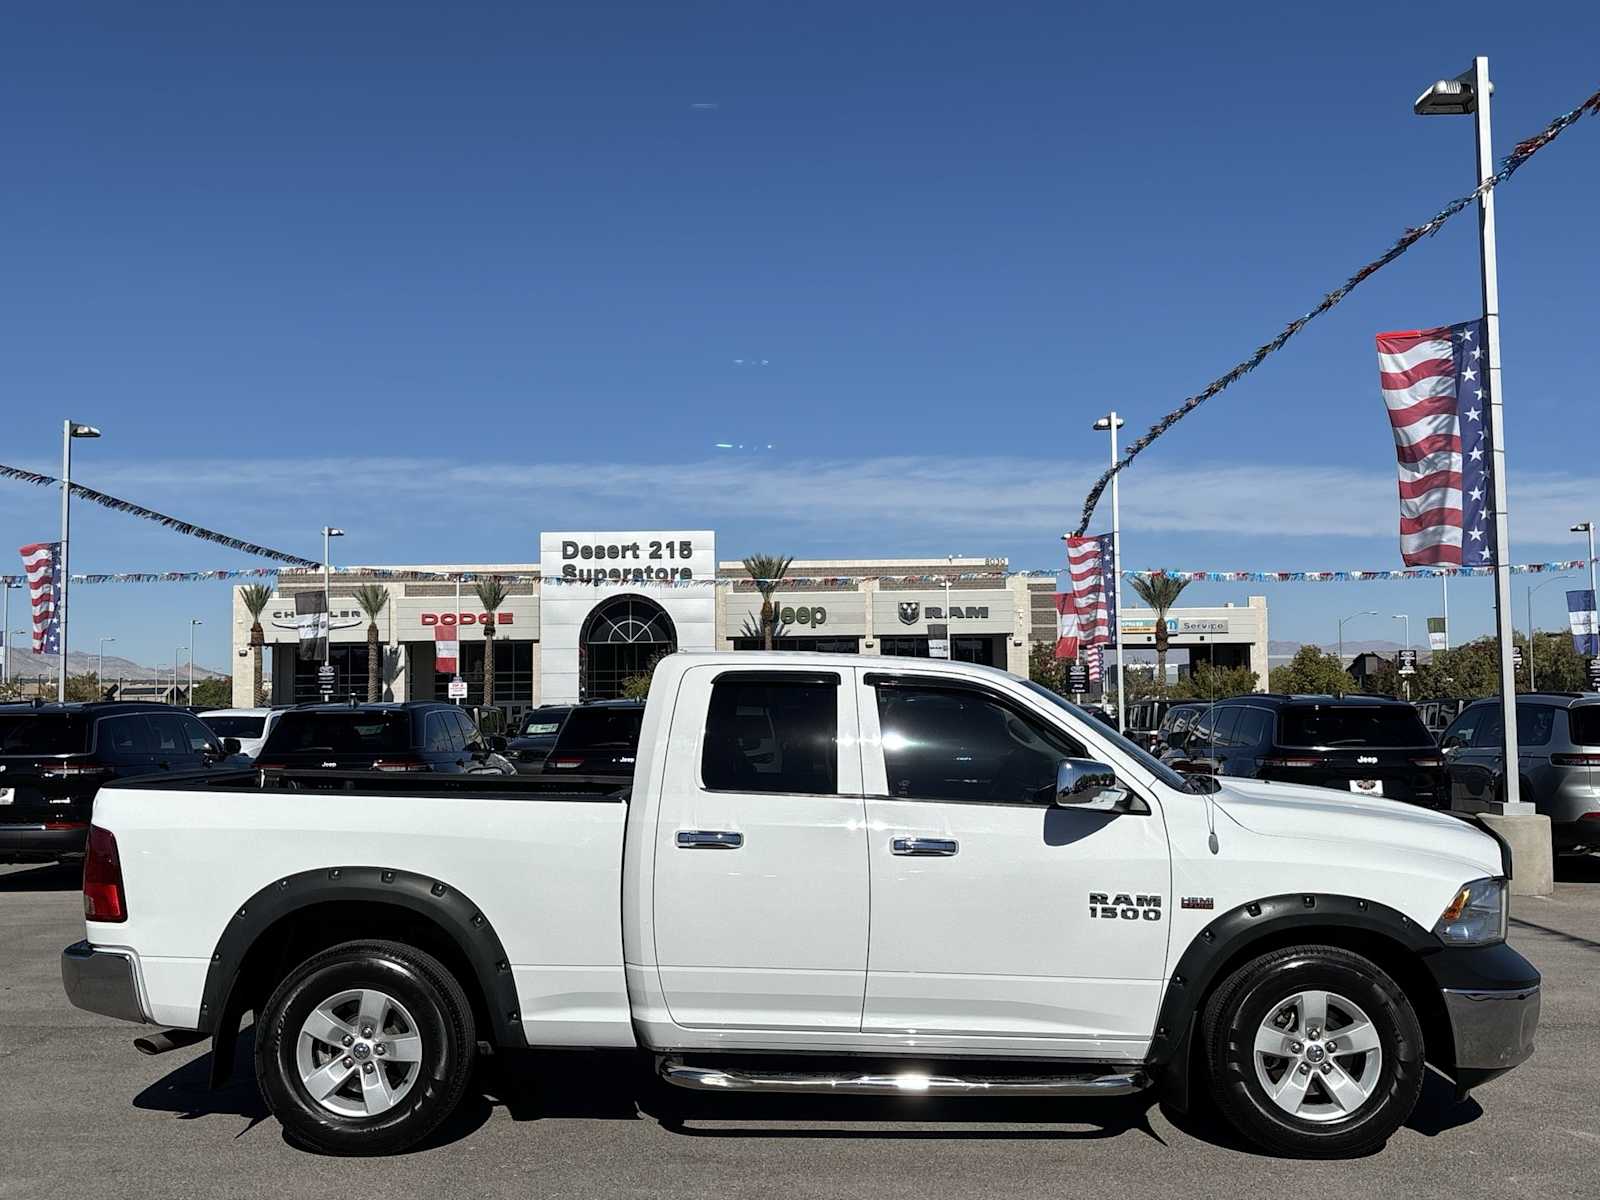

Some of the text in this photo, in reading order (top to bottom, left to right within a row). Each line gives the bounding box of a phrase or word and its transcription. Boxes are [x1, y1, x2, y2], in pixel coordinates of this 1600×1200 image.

[562, 541, 693, 559] Desert 215
[562, 564, 693, 586] Superstore
[273, 611, 361, 619] CHLER
[421, 612, 514, 625] DODGE
[773, 601, 827, 628] Jeep
[924, 607, 989, 619] RAM
[1183, 622, 1224, 630] Service
[1357, 755, 1378, 764] Jeep
[1089, 892, 1162, 908] RAM
[1089, 906, 1162, 921] 1500
